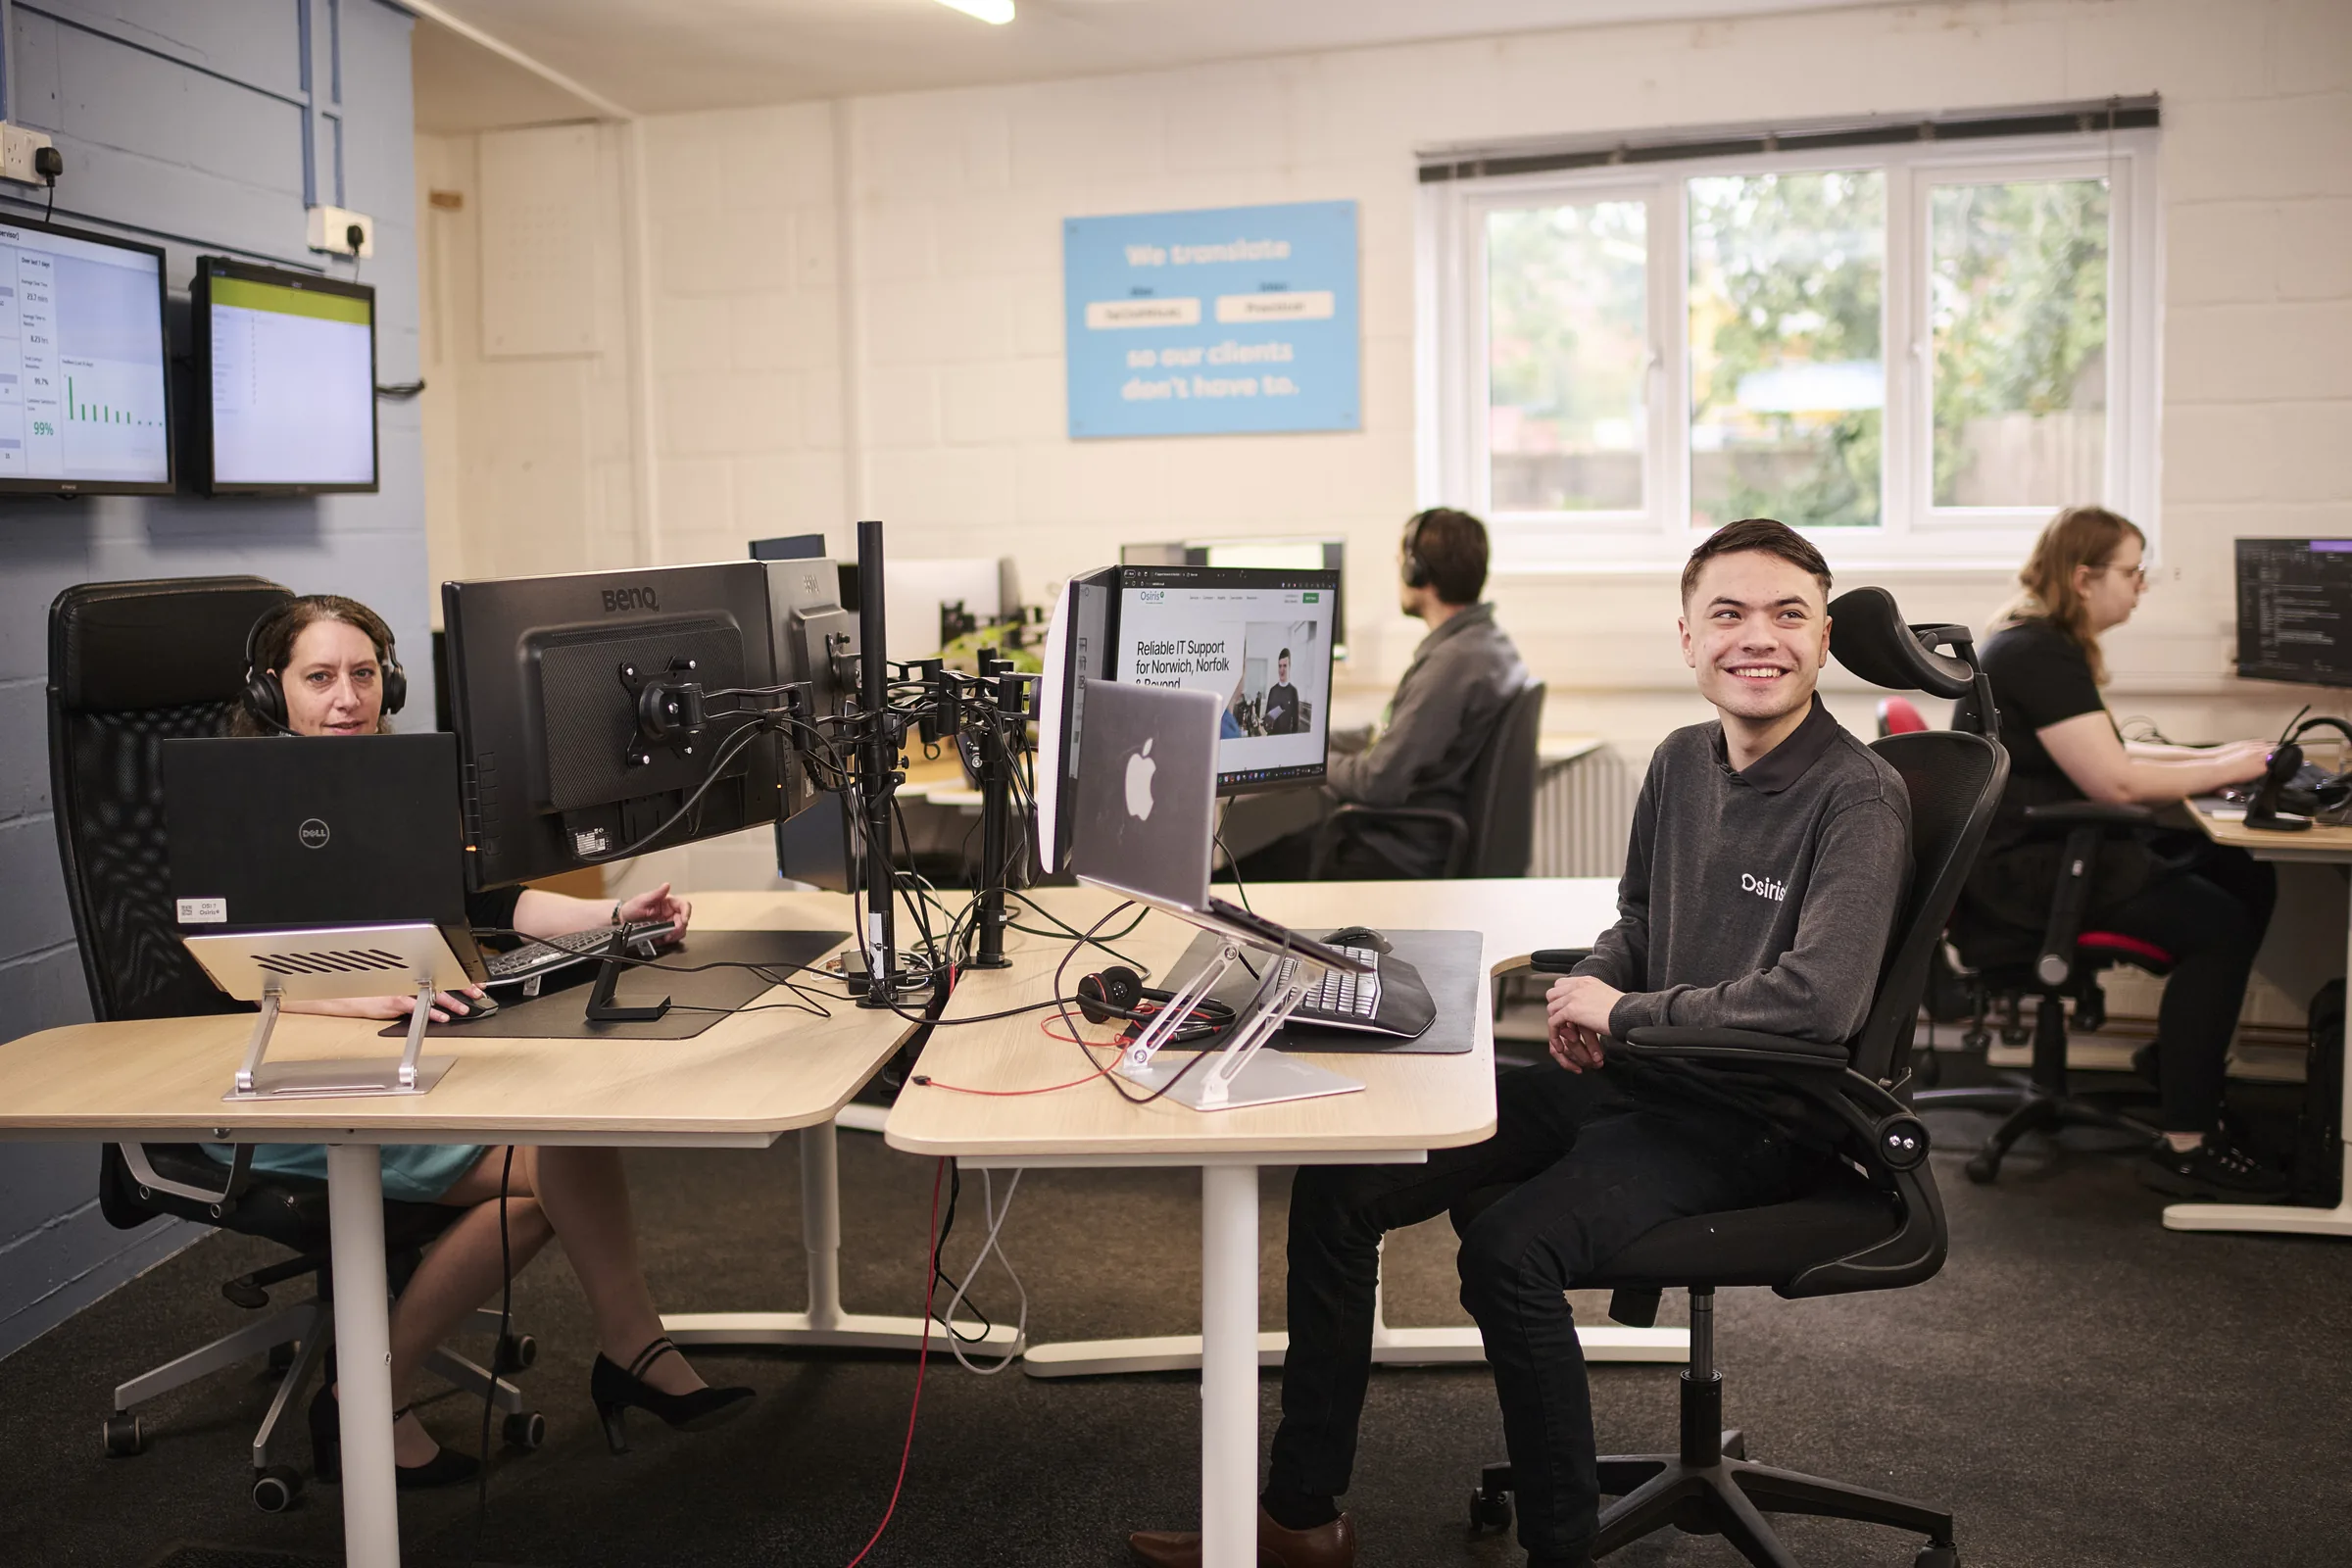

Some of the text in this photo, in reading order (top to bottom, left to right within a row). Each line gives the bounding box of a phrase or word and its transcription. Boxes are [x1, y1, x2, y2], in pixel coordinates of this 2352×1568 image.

[1125, 238, 1291, 267] We translate
[1127, 341, 1294, 368] so our clients
[1122, 375, 1189, 401] don't
[1193, 374, 1258, 397] have
[33, 421, 55, 436] 99%
[602, 587, 661, 612] BenQ
[1140, 591, 1160, 601] Osiris
[1137, 640, 1225, 658] Reliable IT Support
[1136, 657, 1230, 675] for Norwich, Norfolk
[302, 829, 327, 838] DELL
[1741, 872, 1787, 902] Osiris
